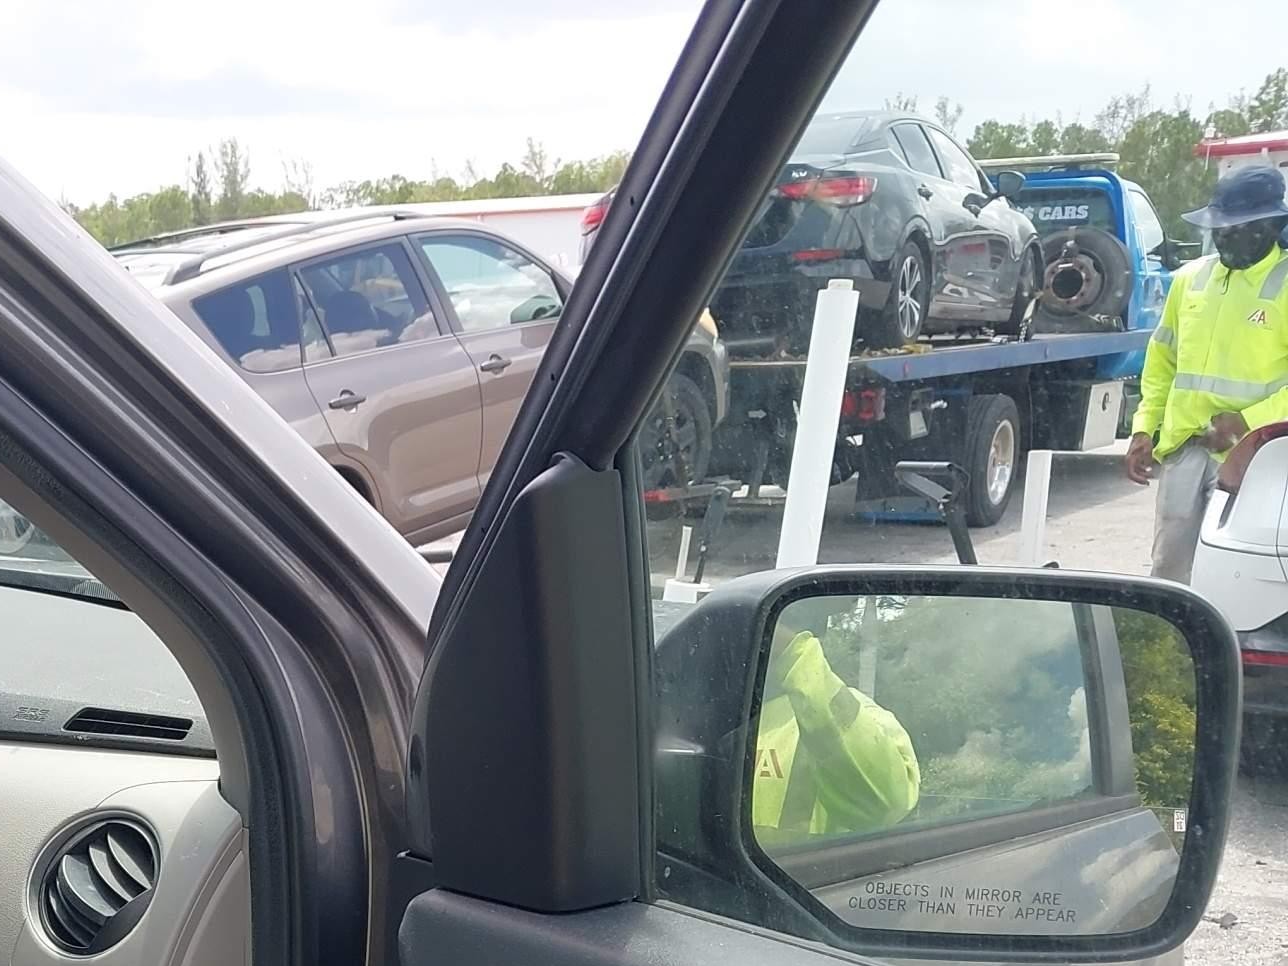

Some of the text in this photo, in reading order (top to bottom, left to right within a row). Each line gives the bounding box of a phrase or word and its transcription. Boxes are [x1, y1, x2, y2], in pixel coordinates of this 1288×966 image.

[1038, 205, 1089, 220] CARS
[864, 881, 1063, 906] OBJECTS IN MIRROR ARE
[848, 896, 1077, 923] CLOSER THAN THEY APPEAR
